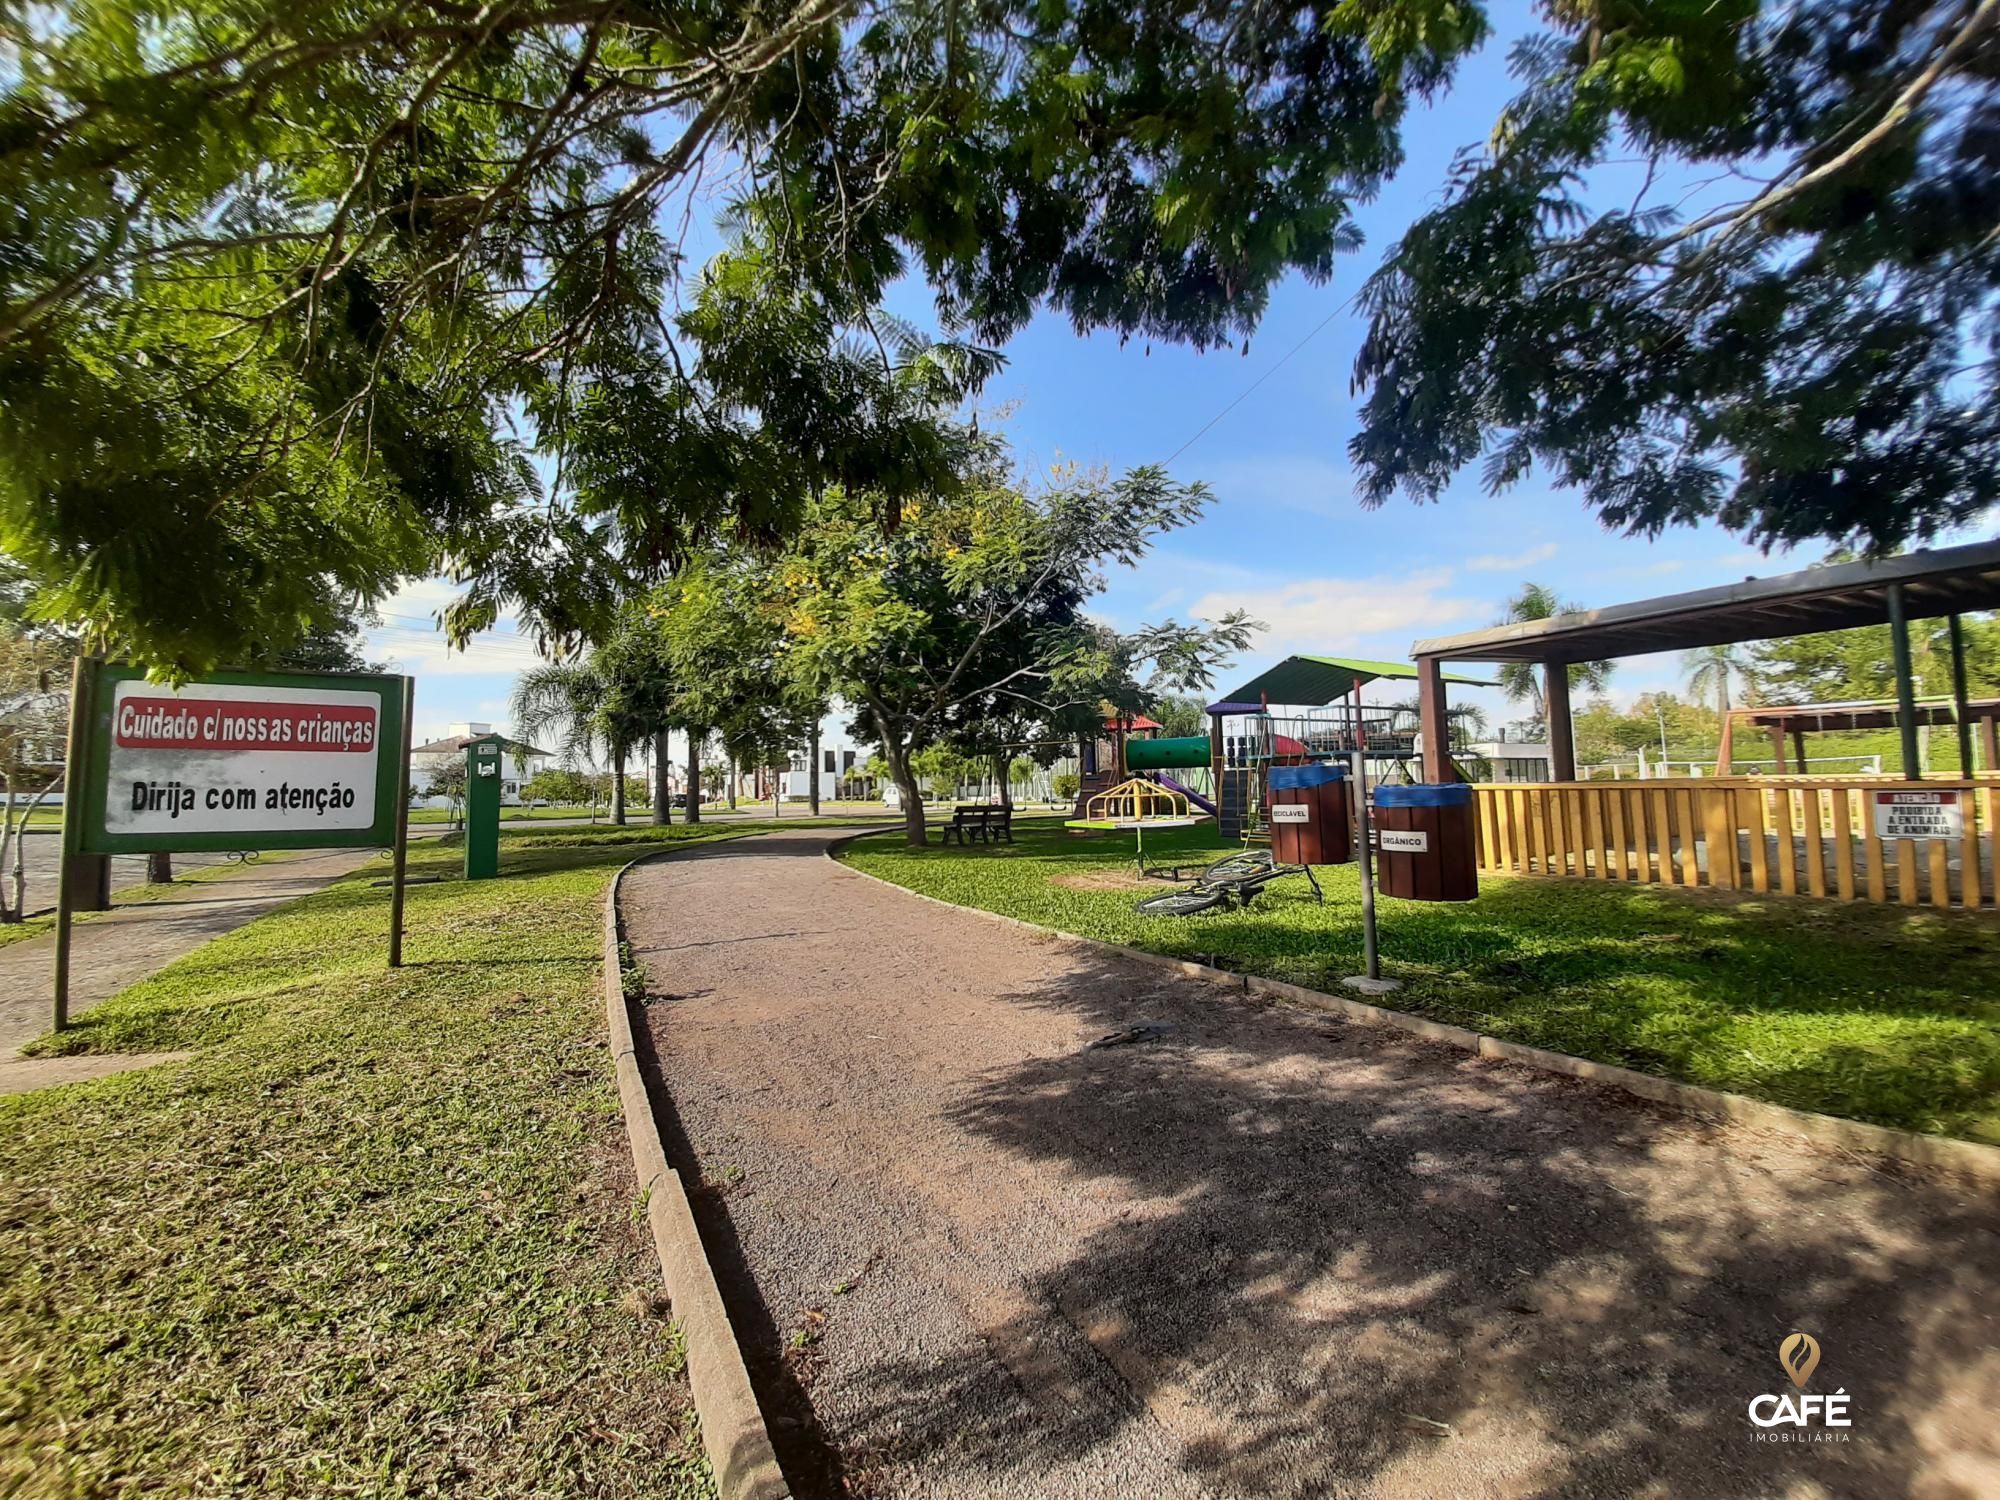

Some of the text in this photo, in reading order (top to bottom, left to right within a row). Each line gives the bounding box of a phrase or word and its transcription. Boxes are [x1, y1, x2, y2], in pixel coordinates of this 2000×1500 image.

[120, 705, 373, 751] Cuidado c/ nossas crianças
[131, 781, 356, 818] Dirija com atenção
[1888, 816, 1948, 825] A ENTRADA
[1887, 825, 1952, 835] DE ANIMAIS
[1382, 836, 1422, 846] ORGÂNICO
